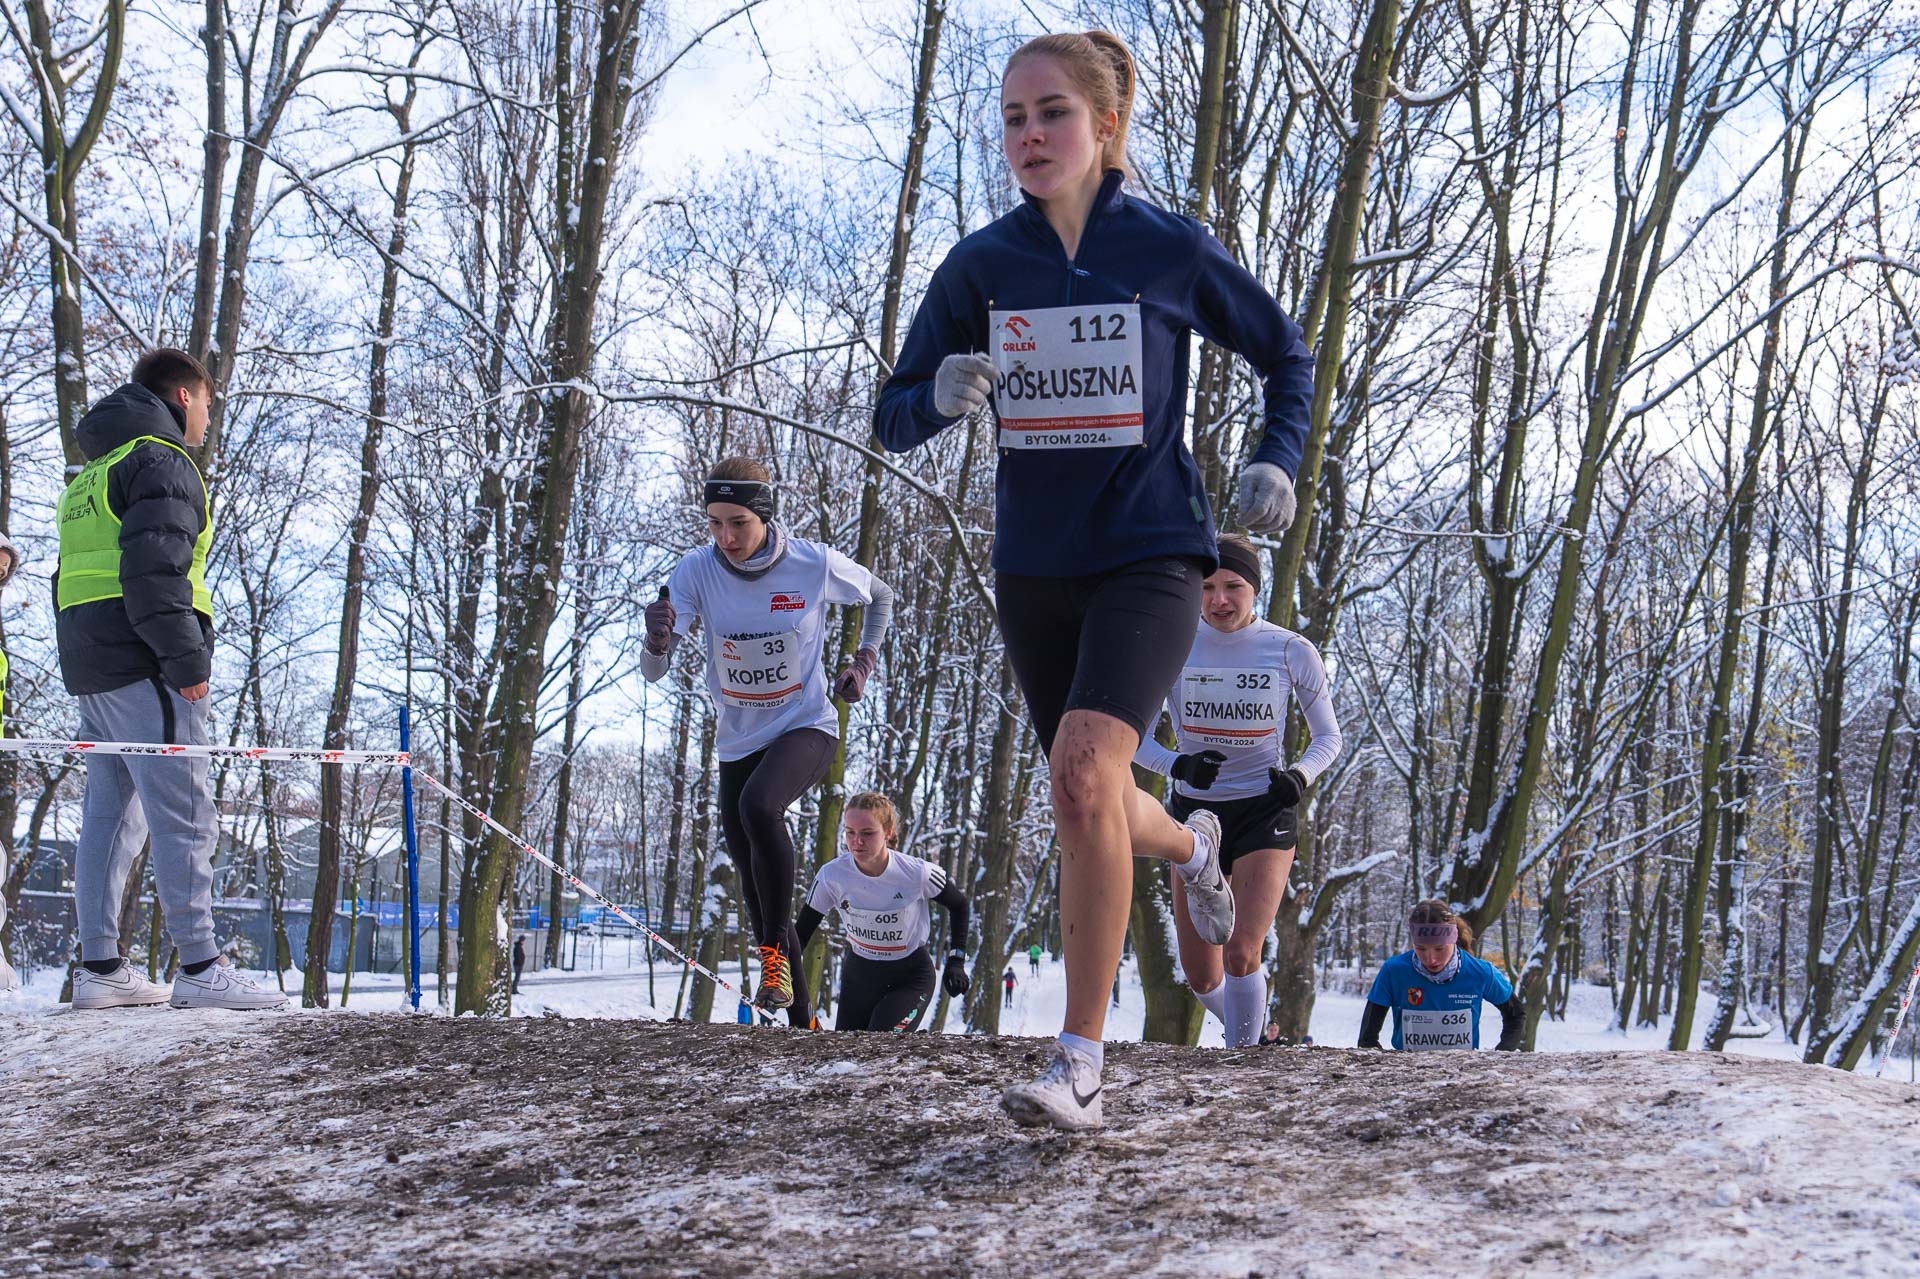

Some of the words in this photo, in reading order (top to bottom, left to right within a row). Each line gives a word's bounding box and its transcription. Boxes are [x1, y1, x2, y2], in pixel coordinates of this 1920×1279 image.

[1069, 313, 1127, 343] 112
[1002, 342, 1036, 352] ORLEN
[997, 364, 1137, 401] POSŁUSZNA
[1025, 434, 1071, 445] BYTOM
[1074, 433, 1107, 444] 2024
[763, 639, 785, 656] 33
[722, 653, 741, 661] ORLEN
[727, 661, 789, 685] KOPEĆ
[1236, 673, 1271, 689] 352
[739, 700, 765, 708] BYTOM
[766, 698, 784, 708] 2024
[1185, 699, 1274, 720] SZYMAŃSKA
[1203, 736, 1233, 745] BYTOM
[875, 913, 898, 923] 605
[846, 923, 903, 942] CHMIELARZ
[1441, 1013, 1467, 1025] 636
[1405, 1032, 1470, 1046] KRAWCZAK
